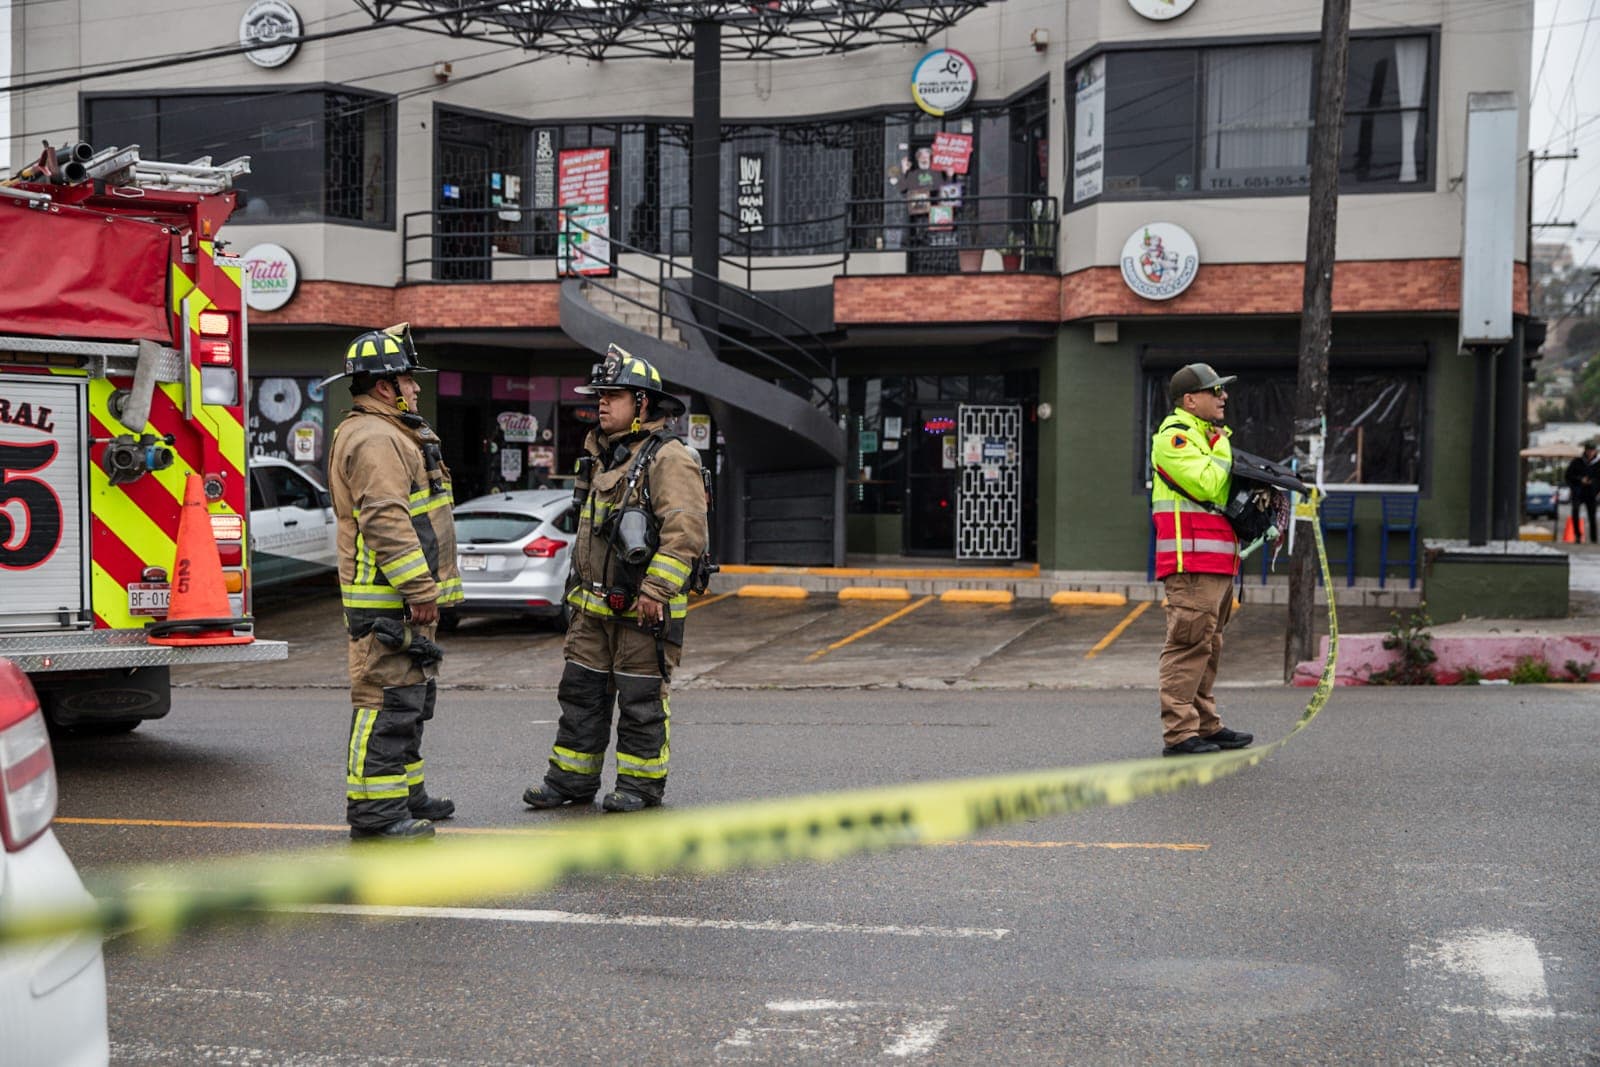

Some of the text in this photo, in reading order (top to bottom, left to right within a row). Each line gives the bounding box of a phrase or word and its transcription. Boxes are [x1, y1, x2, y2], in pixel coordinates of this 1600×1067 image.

[919, 86, 968, 95] DIGITAL
[740, 156, 762, 185] HOY
[738, 195, 763, 206] GRAN
[246, 259, 288, 280] Tutti
[1123, 256, 1158, 295] MARISCOS
[251, 279, 288, 289] DONAS
[500, 414, 533, 430] Tutti
